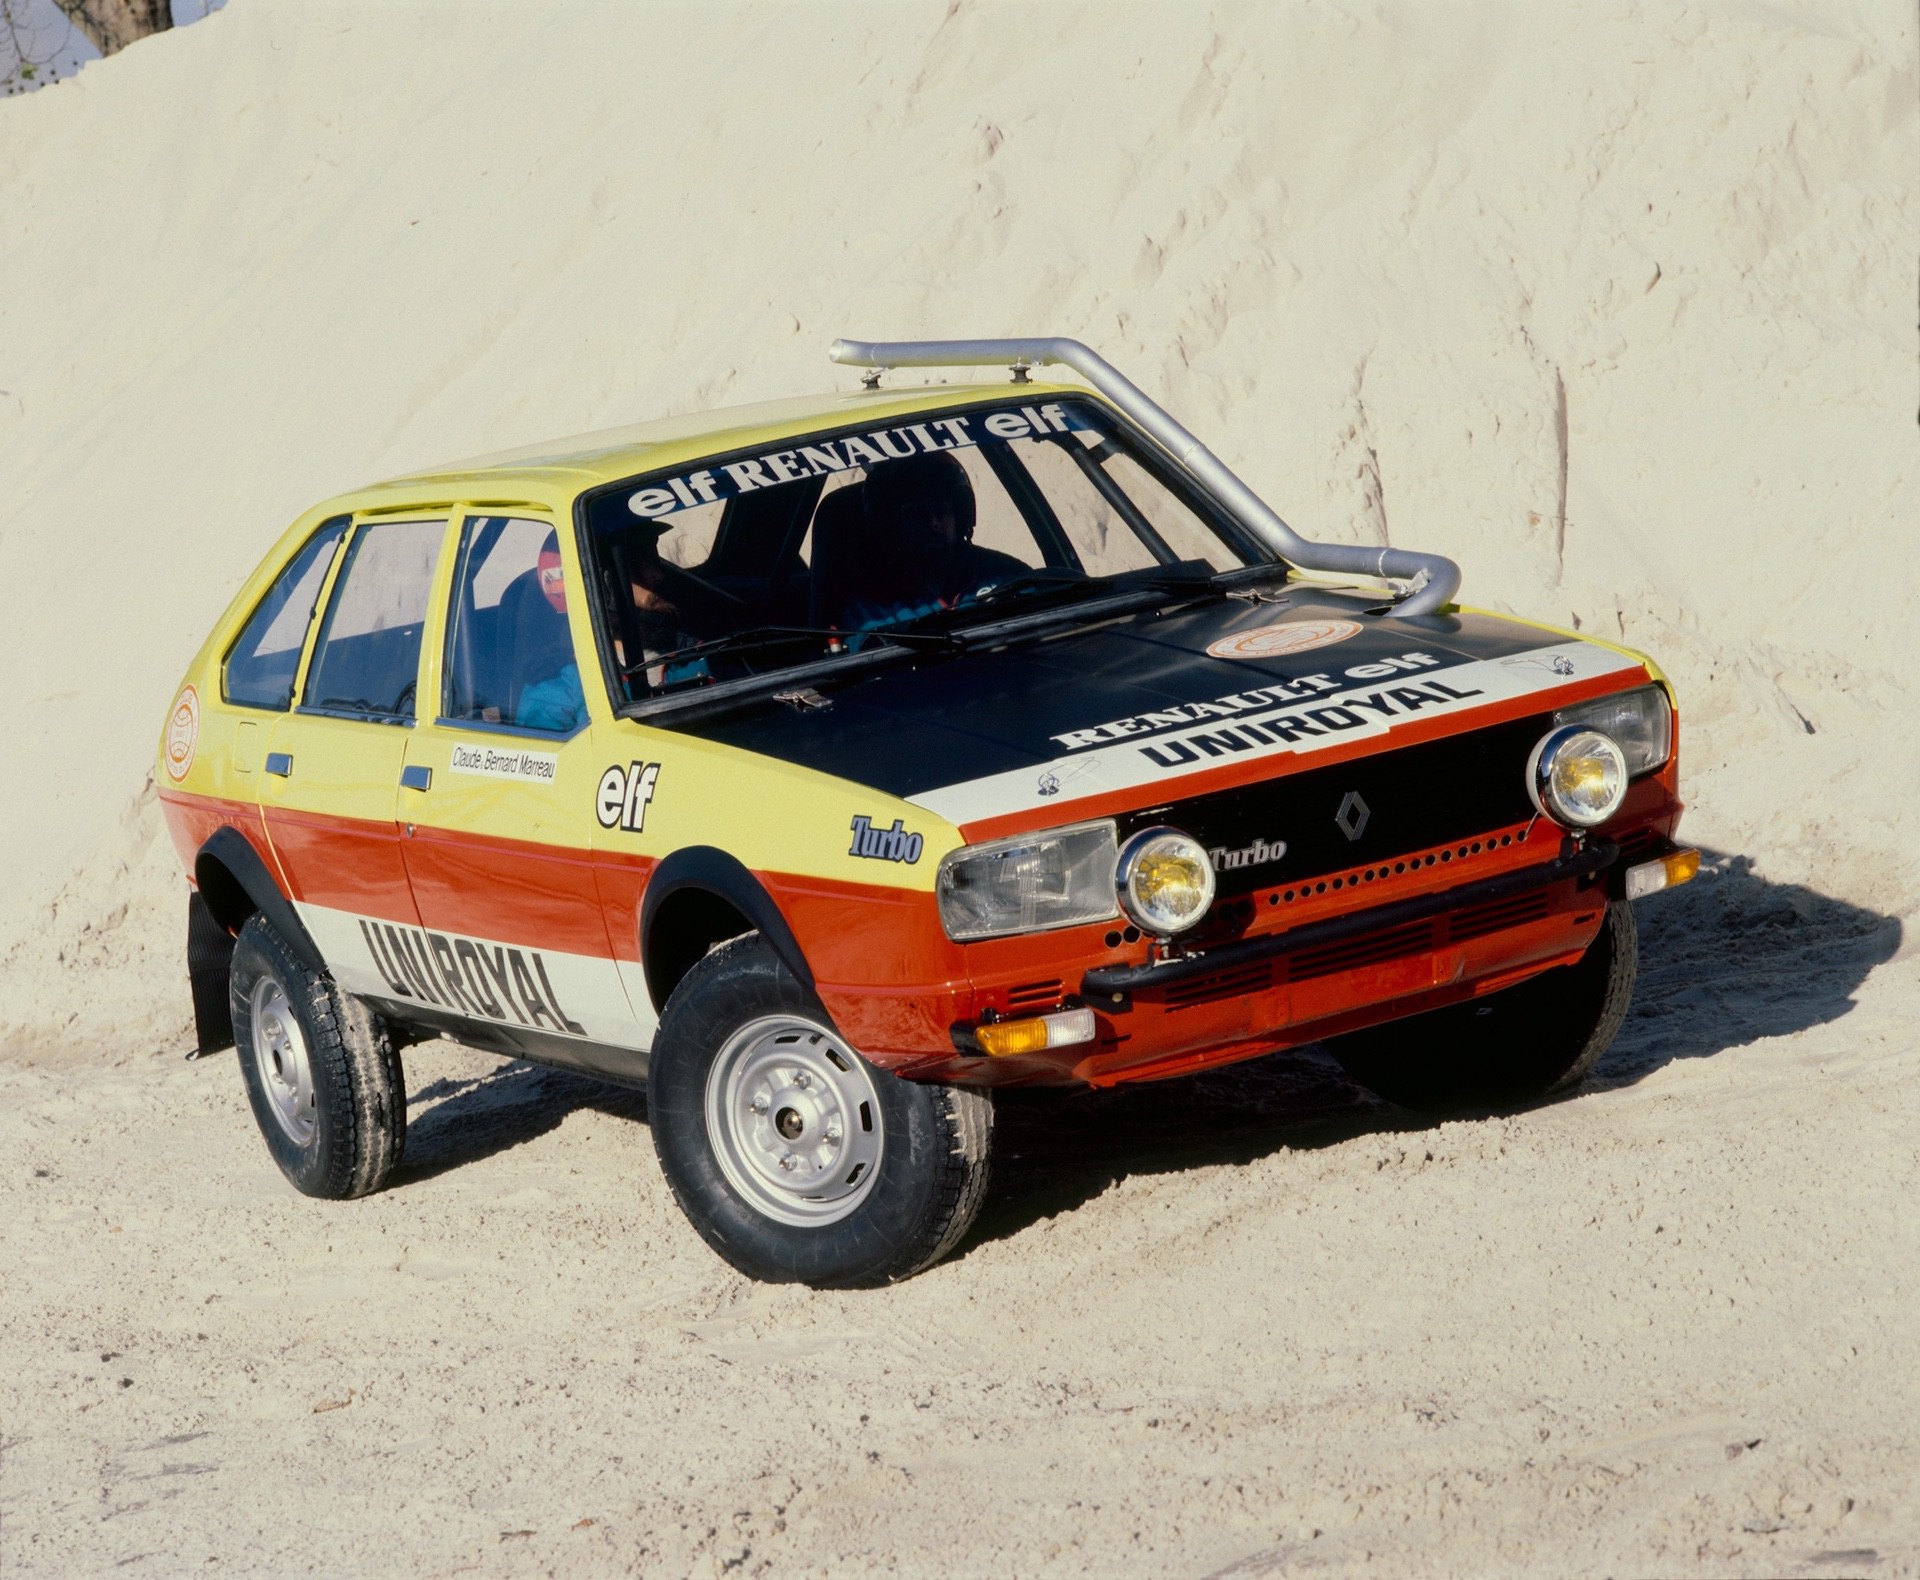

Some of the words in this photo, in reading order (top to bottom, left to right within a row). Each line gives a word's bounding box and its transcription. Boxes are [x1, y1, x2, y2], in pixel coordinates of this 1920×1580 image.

[627, 470, 717, 518] elf
[720, 416, 978, 494] RENAULT
[983, 404, 1069, 440] elf
[1049, 673, 1343, 751] RENAULT
[1344, 652, 1441, 679] elf
[1138, 680, 1485, 768] UNIROYAL
[484, 750, 519, 773] Bernard
[519, 754, 555, 778] Marreau
[596, 760, 662, 833] elf
[848, 814, 924, 865] Turbo
[1208, 837, 1288, 873] Turbo
[358, 919, 589, 1037] UNIROYAL
